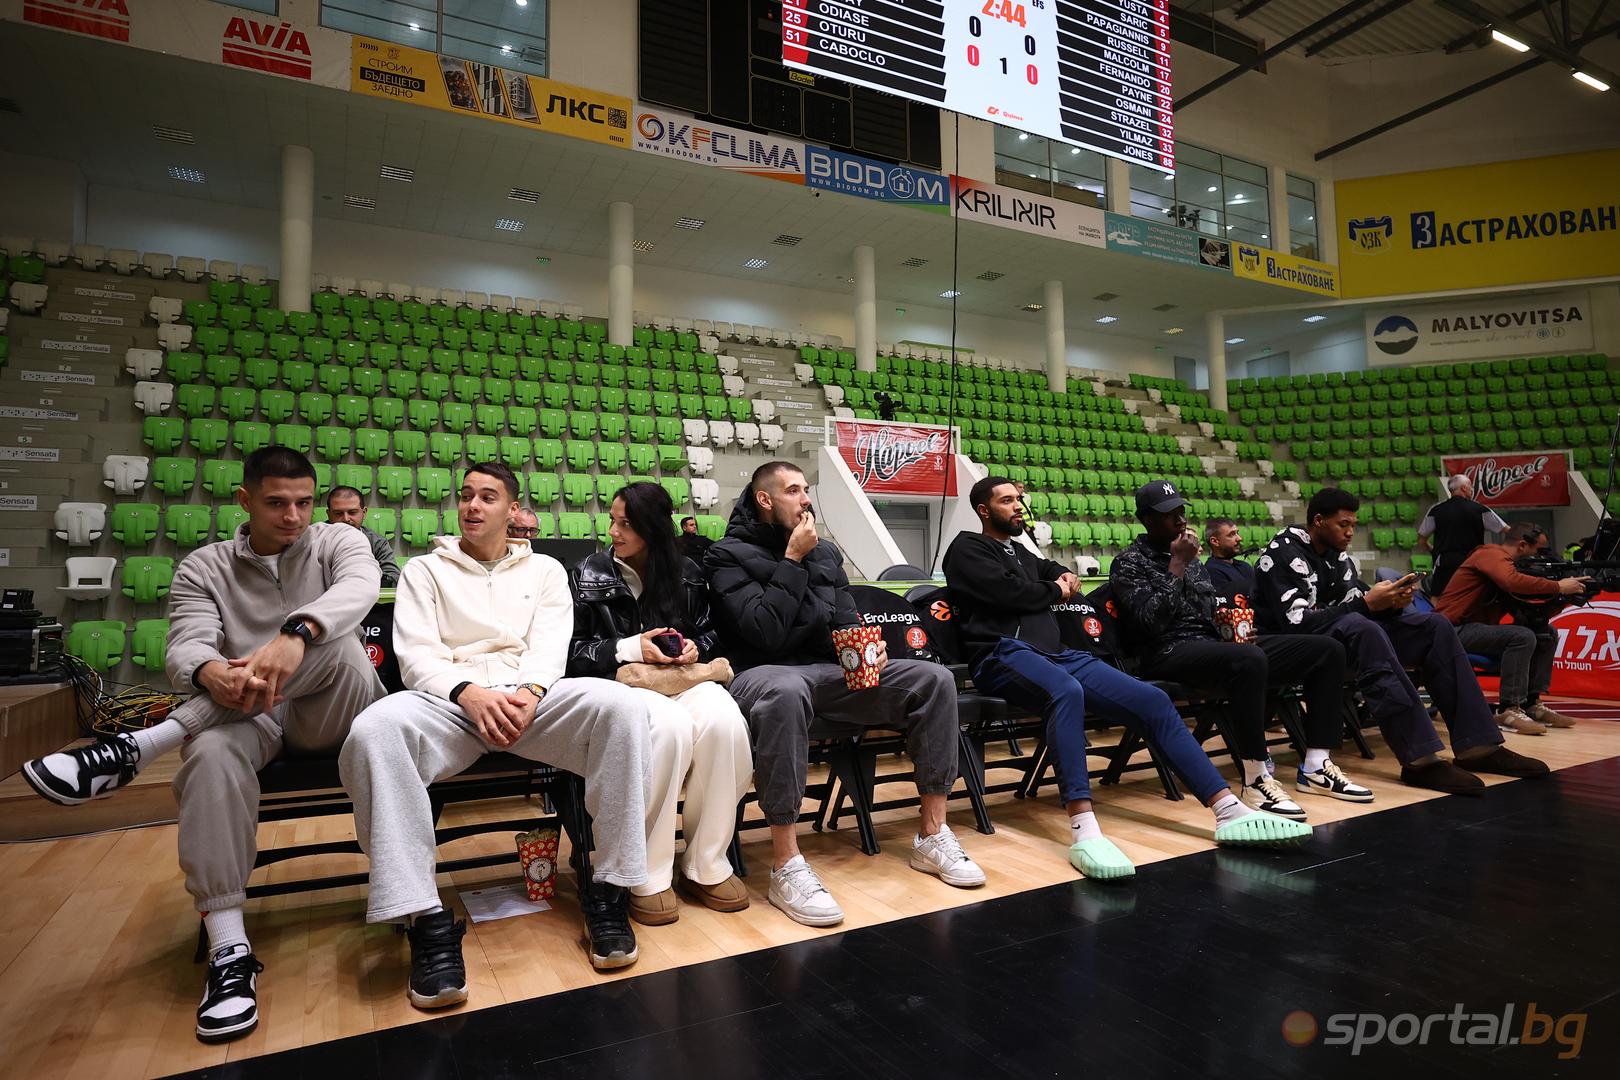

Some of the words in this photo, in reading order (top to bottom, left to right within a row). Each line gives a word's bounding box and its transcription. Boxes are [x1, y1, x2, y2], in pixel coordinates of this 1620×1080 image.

[819, 3, 870, 27] ODIASE
[1118, 0, 1149, 17] YUSTA
[1159, 15, 1165, 23] 4
[1159, 1, 1165, 9] 3
[785, 11, 801, 24] 25
[819, 21, 866, 43] OTURU
[969, 15, 981, 38] 0
[1086, 14, 1150, 45] PAPAGIANNIS
[1160, 43, 1166, 51] 9
[1120, 12, 1148, 30] SARIC
[1160, 28, 1166, 37] 5
[786, 30, 800, 42] 51
[819, 39, 886, 66] CABOCLO
[967, 45, 980, 67] 0
[1024, 35, 1036, 56] 0
[1107, 36, 1149, 59] RUSSELL
[1159, 57, 1169, 67] 11
[368, 57, 413, 76] СТРОИМ
[1000, 57, 1008, 75] 1
[1026, 64, 1038, 85] 0
[1103, 50, 1150, 74] MALCOLM
[1160, 71, 1169, 80] 17
[364, 70, 421, 90] БЪДЕЩЕТО
[371, 82, 414, 99] ЗАЕДНО
[1099, 63, 1151, 88] FERNANDO
[1160, 84, 1170, 95] 20
[1121, 85, 1152, 103] PAYNE
[1161, 99, 1171, 109] 22
[546, 94, 605, 125] ЛКС
[1115, 98, 1152, 117] OSMANI
[1161, 113, 1171, 124] 24
[1110, 111, 1152, 132] STRAZEL
[1162, 128, 1172, 138] 32
[1119, 129, 1153, 147] YILMAZ
[1162, 142, 1173, 153] 33
[1123, 145, 1154, 161] JONES
[1163, 157, 1173, 168] 88
[1411, 206, 1620, 249] ЗАСТРАХОВАН
[1267, 257, 1335, 291] ЗАСТРАХОВАНЕ
[1431, 306, 1583, 333] MALYOVITSA
[25, 449, 57, 458] Sensata
[855, 428, 941, 486] Hapoel
[1464, 456, 1549, 500] Hapoel
[0, 497, 35, 505] Sensata
[863, 612, 921, 625] EroLeagu
[1050, 602, 1096, 615] uroLeagu
